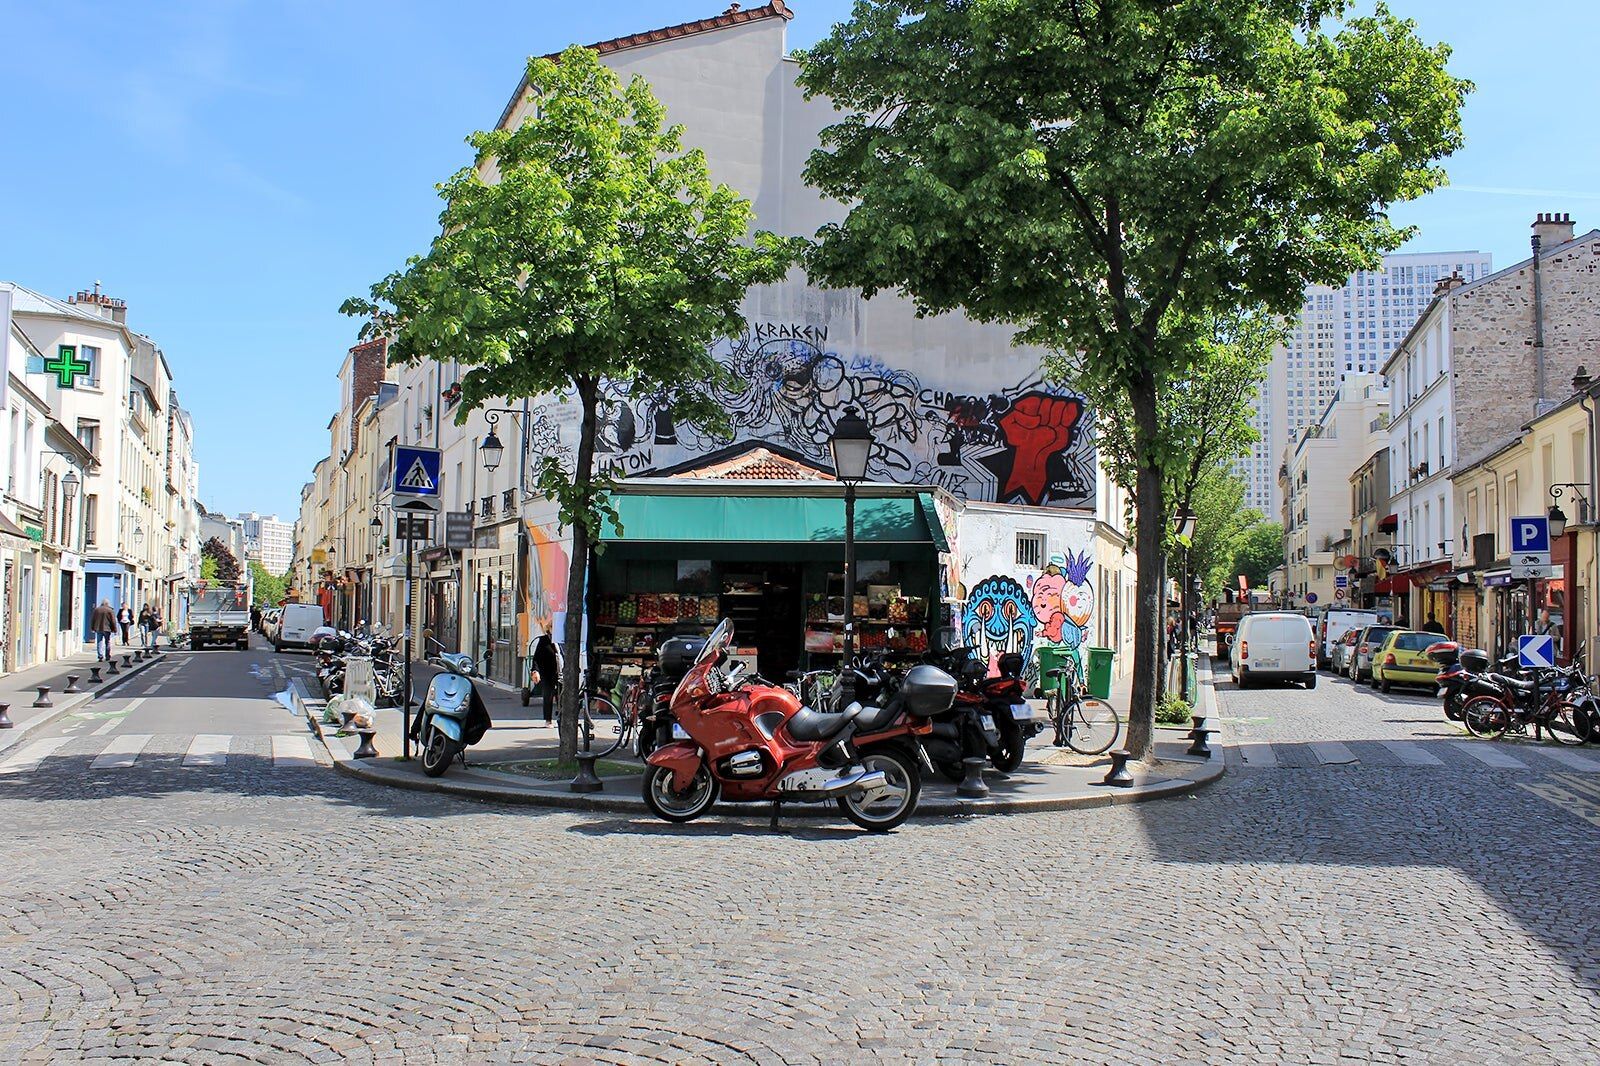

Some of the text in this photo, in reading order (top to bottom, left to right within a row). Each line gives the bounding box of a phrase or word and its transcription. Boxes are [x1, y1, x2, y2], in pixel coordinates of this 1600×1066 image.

[755, 322, 828, 342] KRAKEN
[592, 448, 652, 480] HATON
[1521, 523, 1539, 546] P
